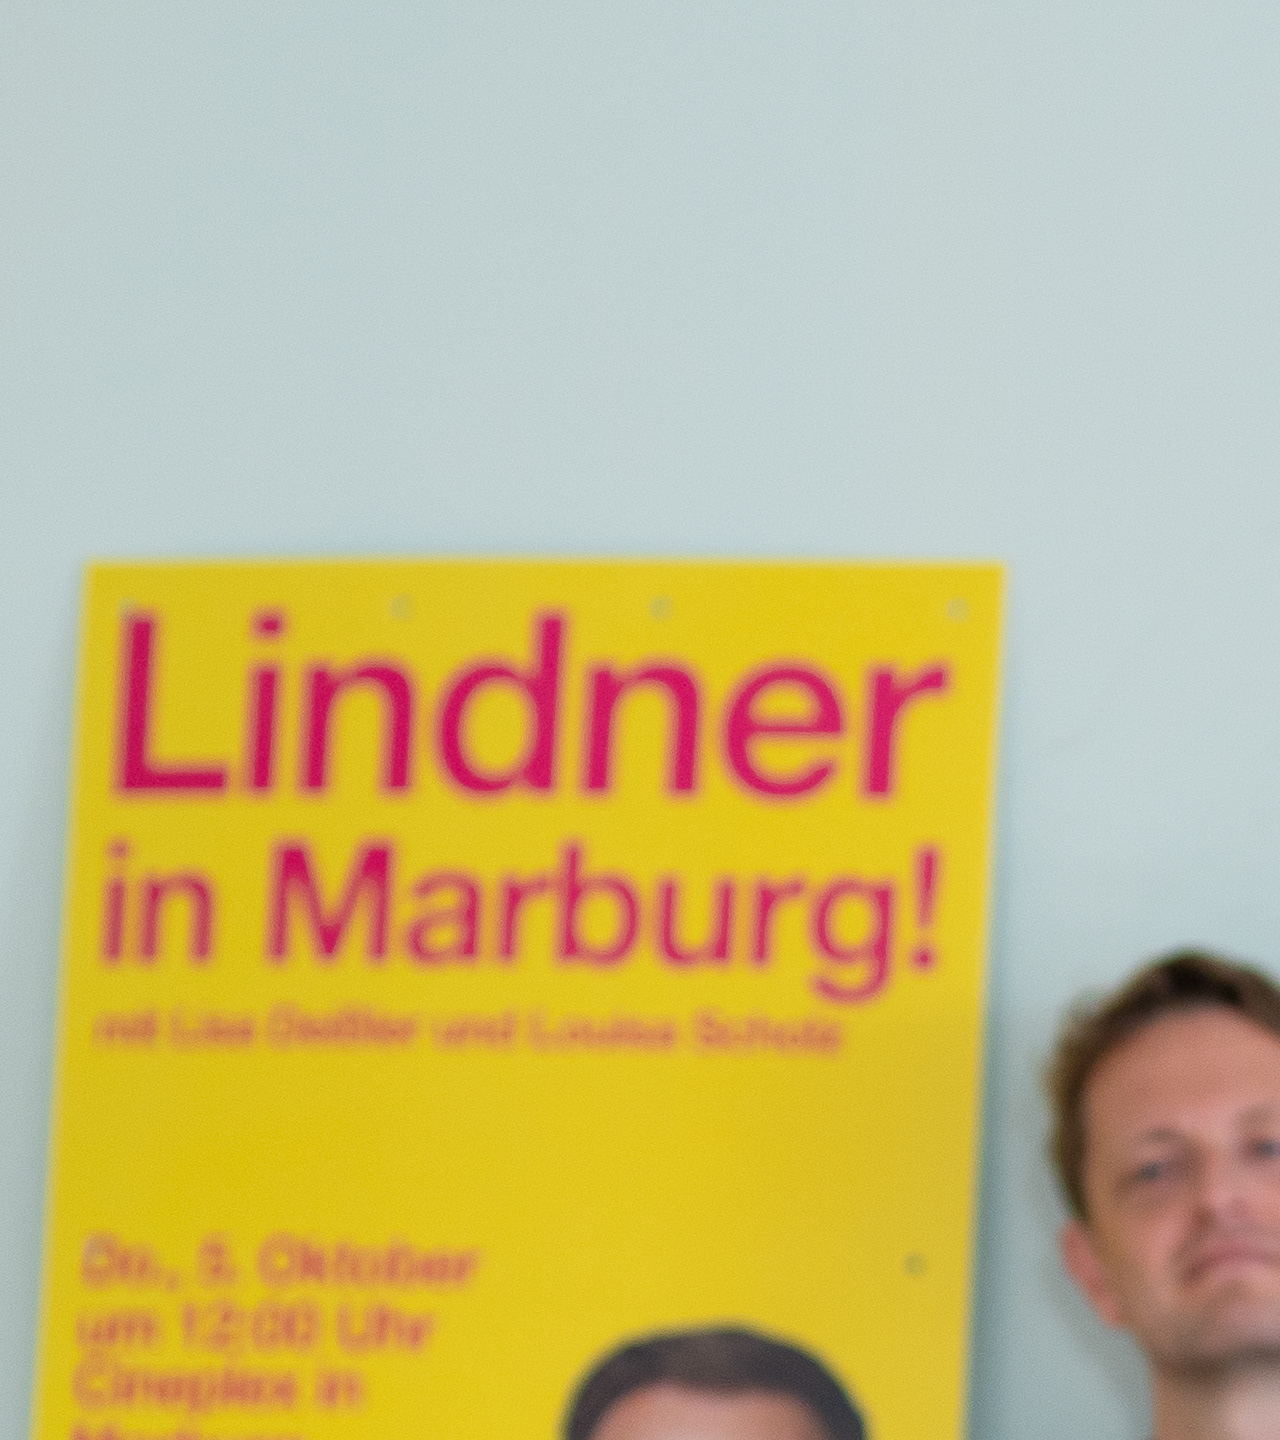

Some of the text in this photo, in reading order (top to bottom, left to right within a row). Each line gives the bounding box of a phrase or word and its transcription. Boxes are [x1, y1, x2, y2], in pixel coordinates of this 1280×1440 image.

[114, 611, 949, 801] Lindner
[102, 840, 938, 1003] in Marburg!
[430, 1010, 521, 1049] und
[257, 1233, 477, 1289] Oktober
[77, 1302, 433, 1353] um 12:00 Uhr
[73, 1361, 364, 1414] Cineplex in
